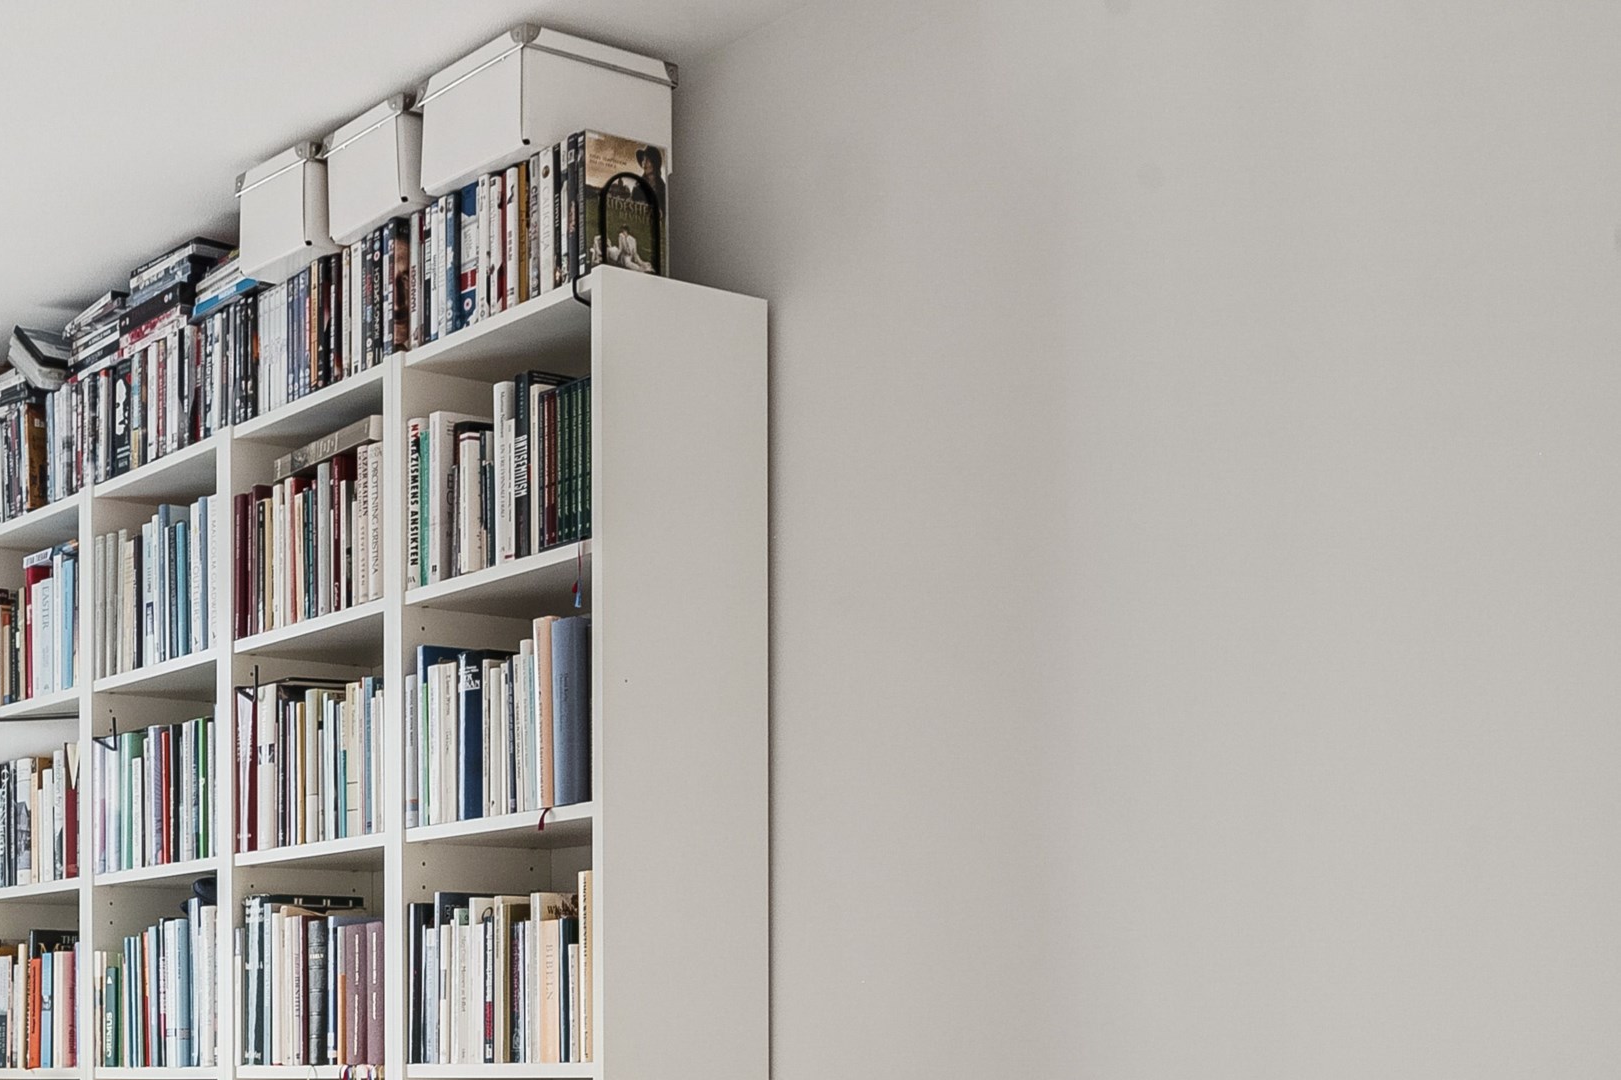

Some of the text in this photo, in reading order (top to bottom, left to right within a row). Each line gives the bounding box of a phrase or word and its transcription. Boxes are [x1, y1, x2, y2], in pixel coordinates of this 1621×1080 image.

[411, 424, 420, 566] NYNAZISMENS ANSIKTEN
[515, 434, 528, 498] ANTISEMITISM
[371, 460, 379, 575] DROTTNING KRISTINA
[42, 586, 50, 630] EASTER
[192, 566, 200, 622] OUTLIERS
[546, 944, 554, 1000] BIBELN
